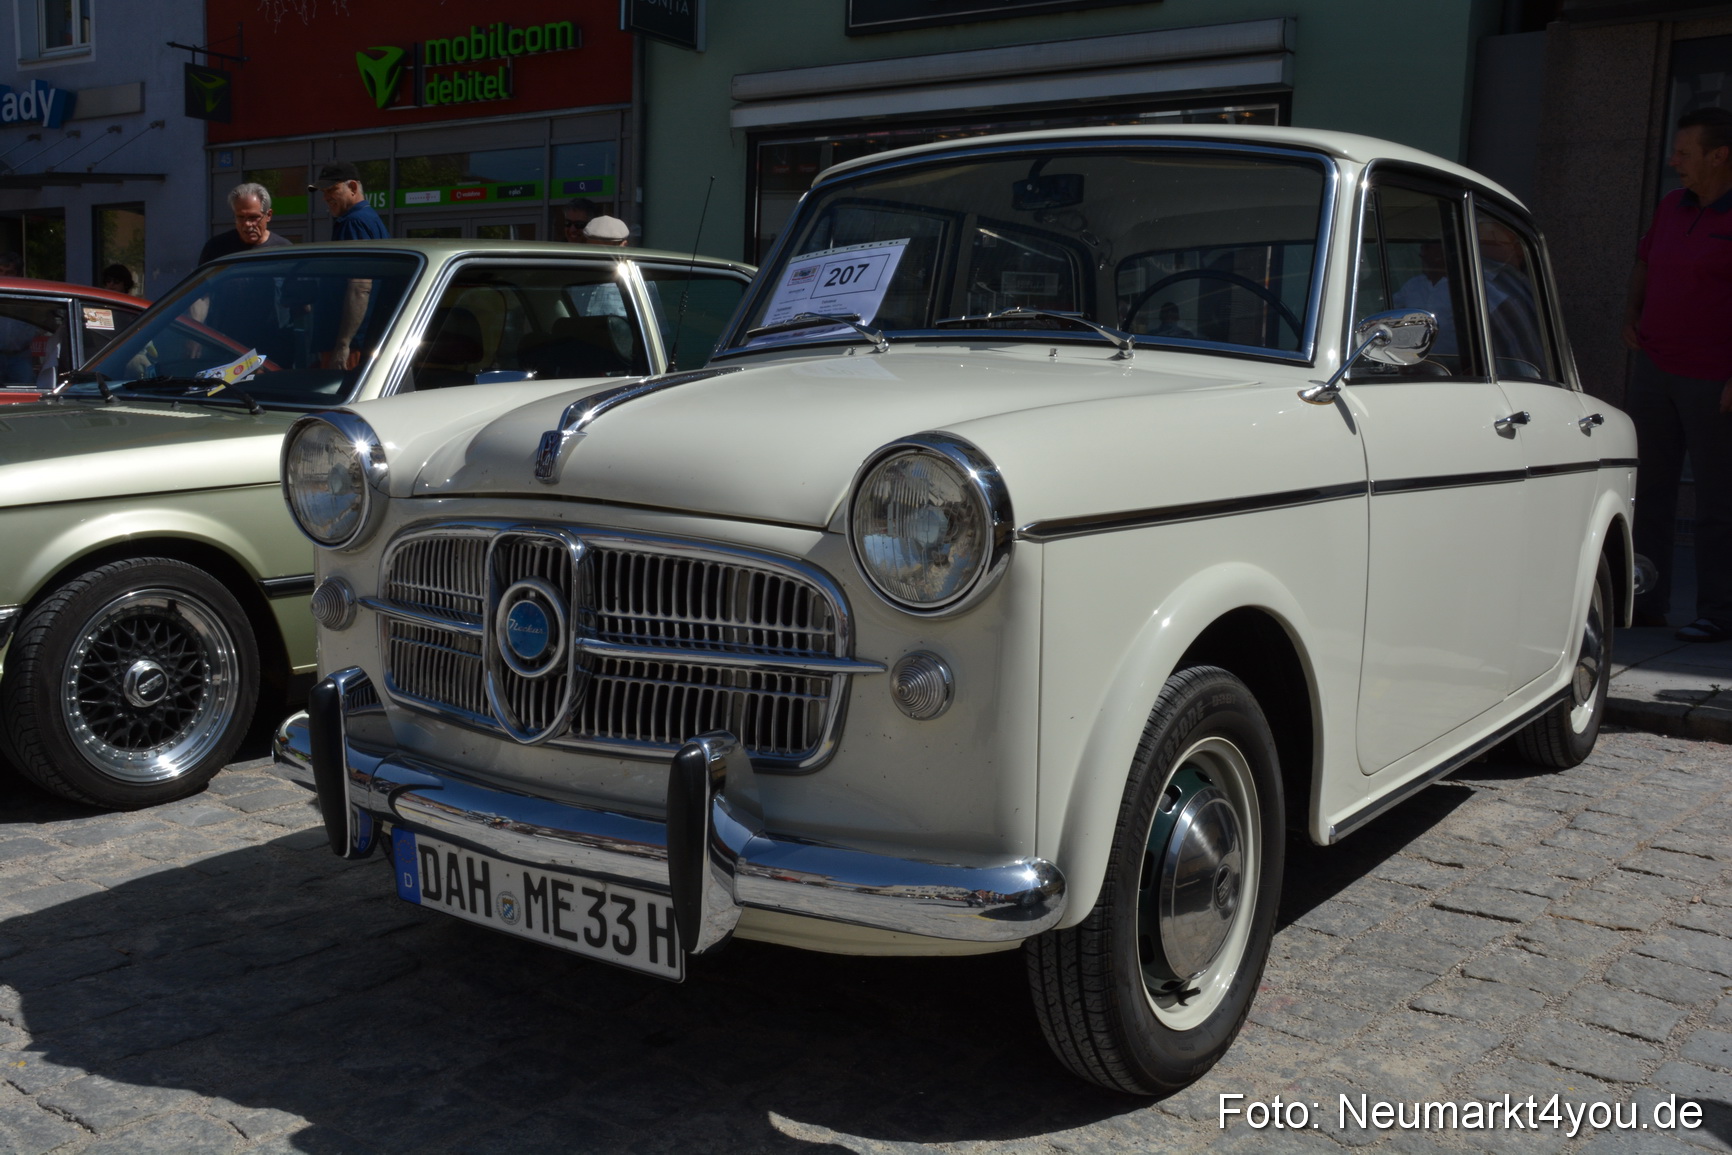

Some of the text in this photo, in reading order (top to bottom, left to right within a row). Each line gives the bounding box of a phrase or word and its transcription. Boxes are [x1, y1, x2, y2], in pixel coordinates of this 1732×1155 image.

[425, 20, 574, 65] mobilcom
[425, 65, 508, 105] debitel
[824, 263, 870, 287] 207
[403, 872, 413, 888] D
[418, 843, 492, 918] DAH
